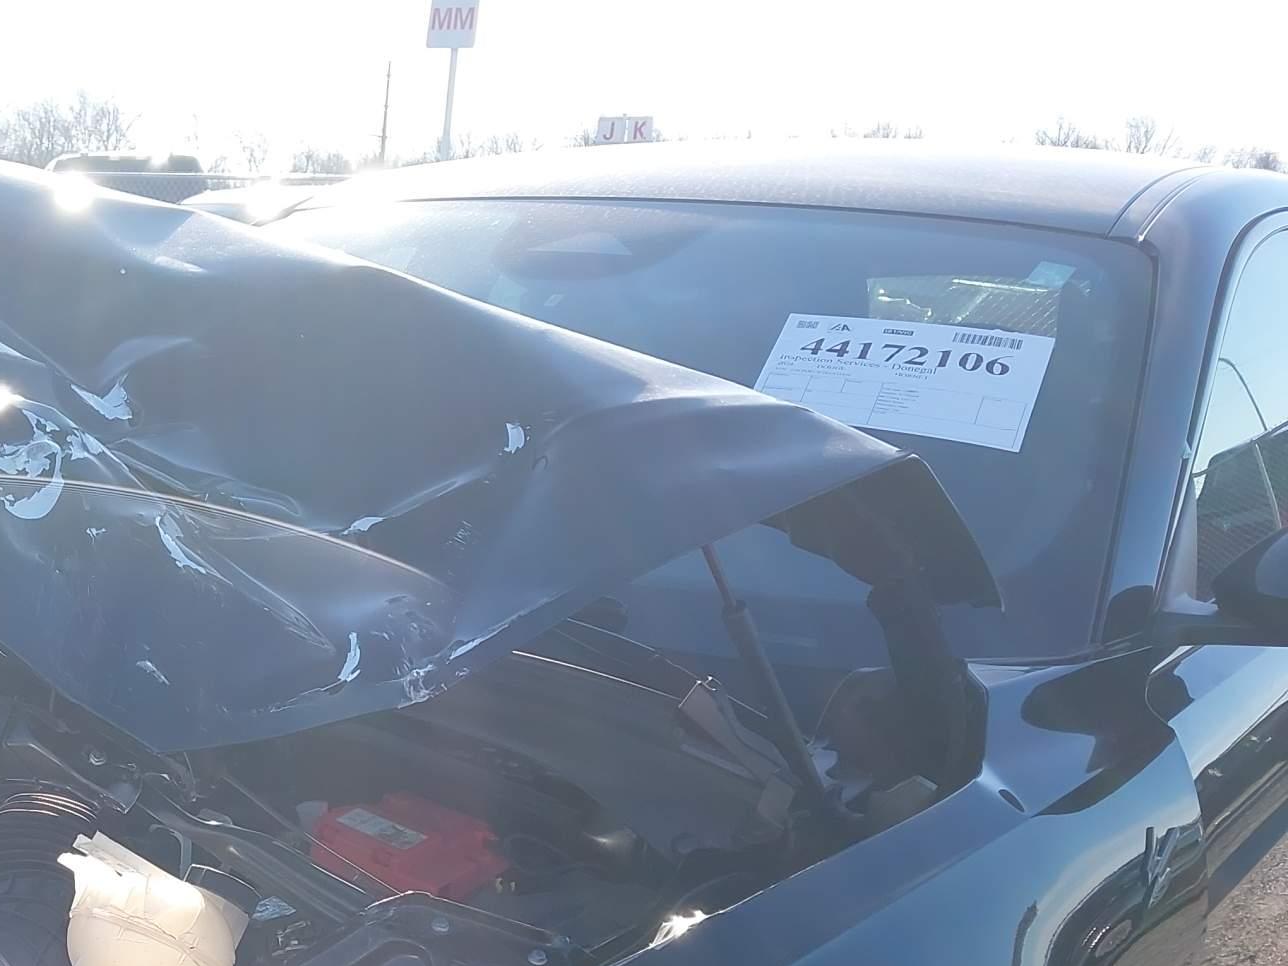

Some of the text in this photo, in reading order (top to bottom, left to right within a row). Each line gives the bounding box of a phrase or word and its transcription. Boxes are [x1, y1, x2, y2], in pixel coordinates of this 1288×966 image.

[431, 7, 475, 31] MM
[602, 121, 616, 141] J
[632, 120, 647, 141] K
[779, 353, 833, 364] Inspection
[837, 357, 881, 369] Services
[891, 362, 938, 376] Donegal
[800, 336, 1014, 376] 44172106
